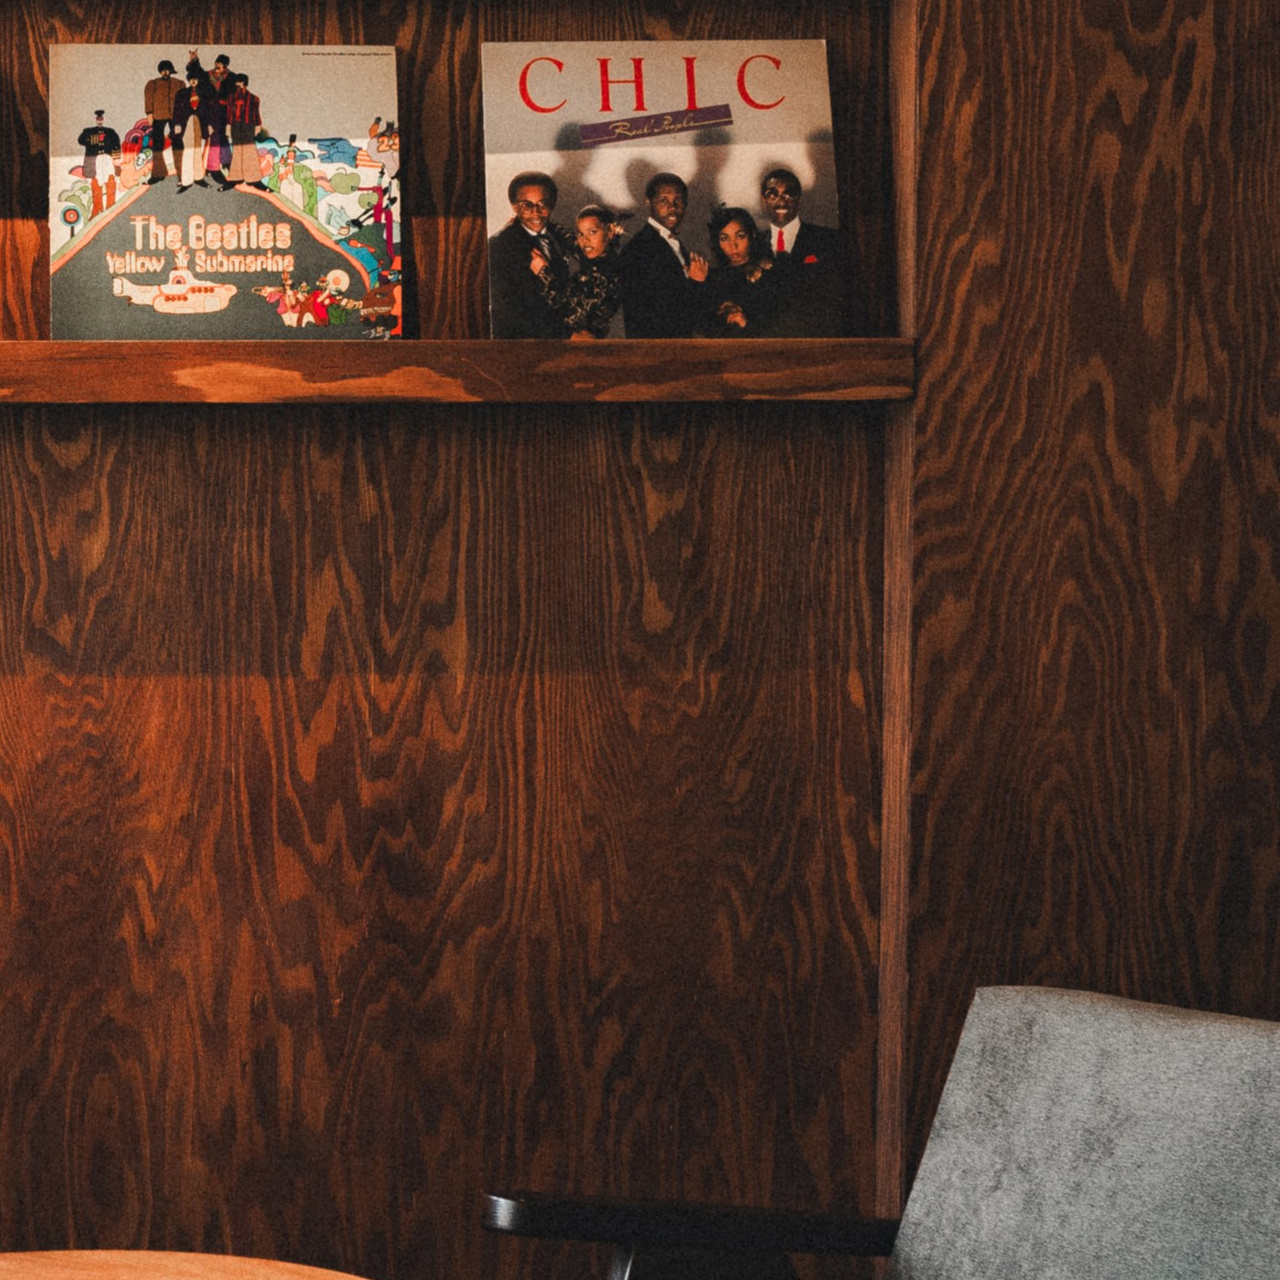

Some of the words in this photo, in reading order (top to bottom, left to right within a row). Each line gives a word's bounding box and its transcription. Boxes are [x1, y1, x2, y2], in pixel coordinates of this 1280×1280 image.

[518, 54, 786, 114] CHIC
[130, 215, 183, 250] The
[188, 214, 292, 250] Beatles
[105, 251, 166, 274] Yellow
[195, 249, 295, 274] Submarine
